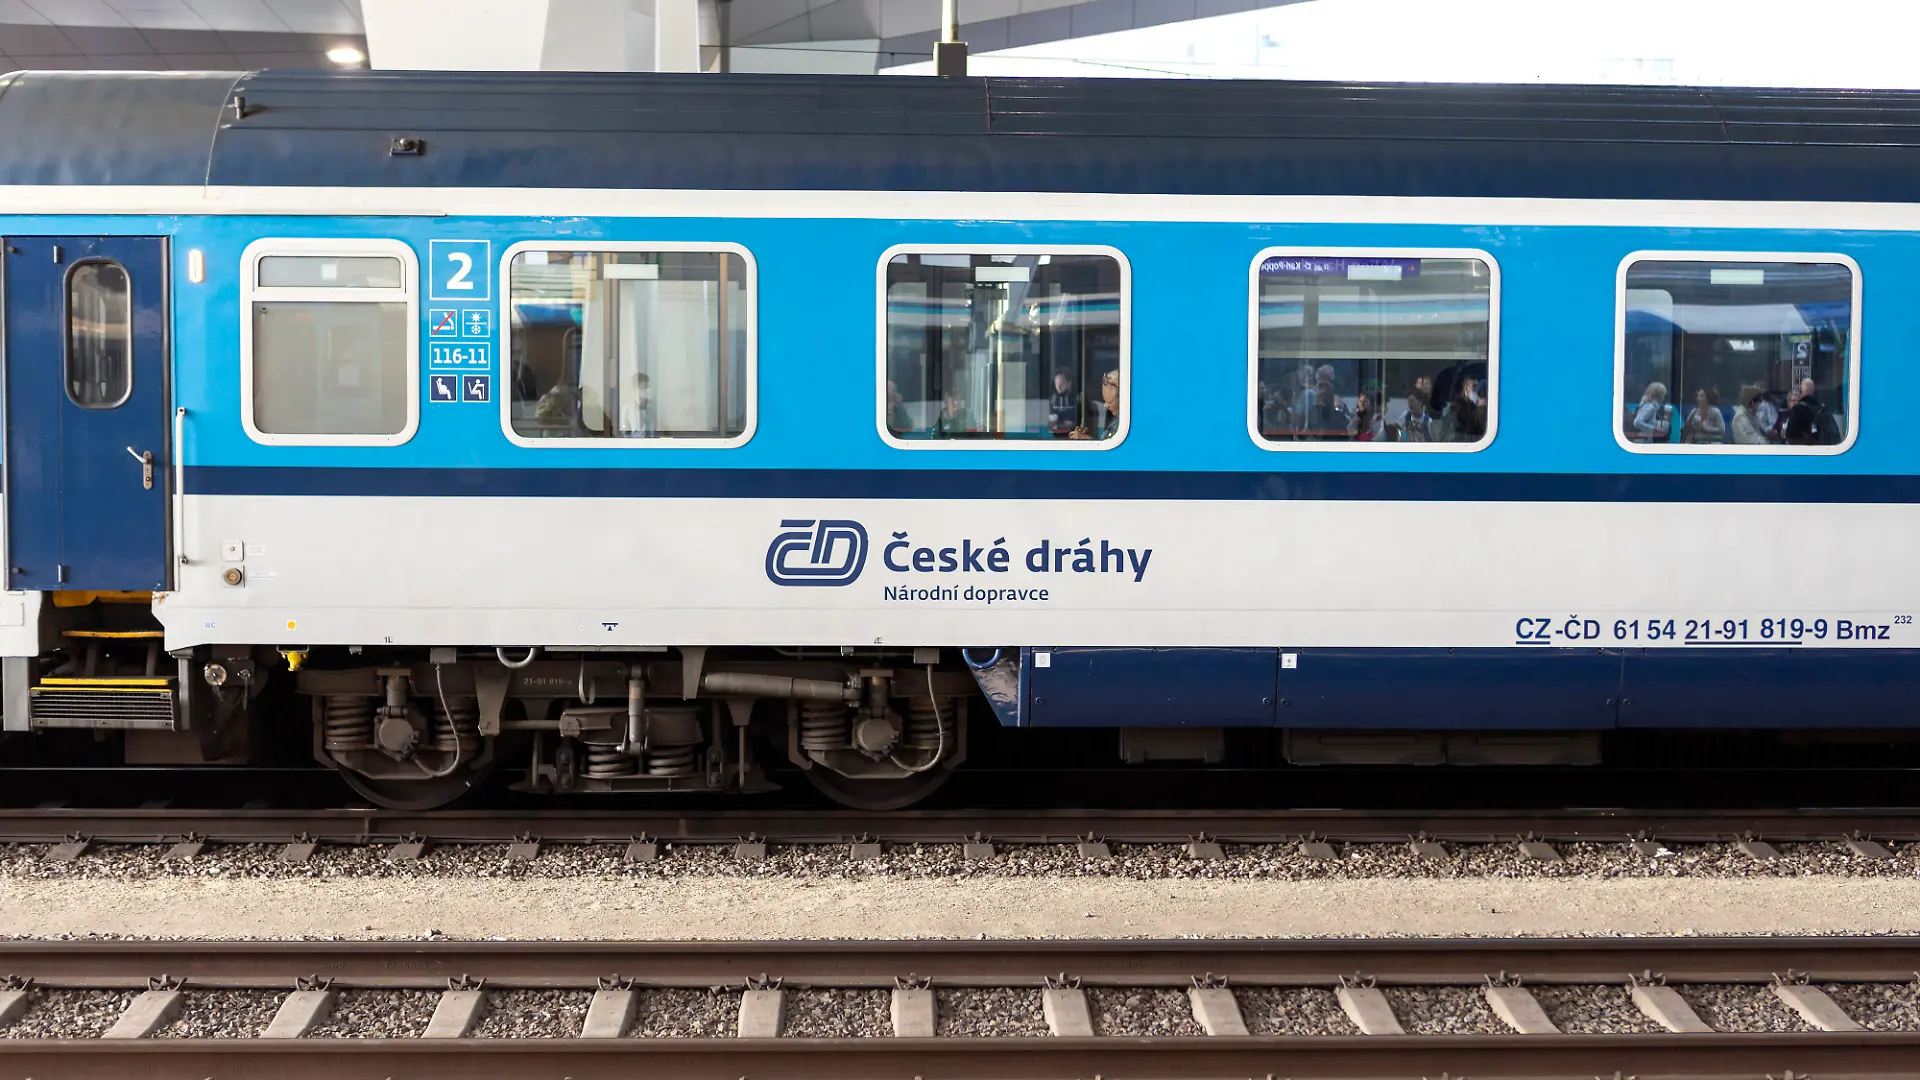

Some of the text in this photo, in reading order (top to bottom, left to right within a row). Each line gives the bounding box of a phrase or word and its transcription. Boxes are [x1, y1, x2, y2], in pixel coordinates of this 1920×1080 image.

[447, 252, 473, 289] 2
[433, 348, 487, 364] 116-11
[883, 531, 1152, 582] České dráhy
[884, 585, 1049, 604] Národní dopravce
[1613, 619, 1639, 640] 61
[1647, 619, 1676, 640] 54
[1685, 619, 1748, 640] 21-91
[1760, 618, 1828, 640] 819-9
[1836, 620, 1890, 640] Bmz
[1894, 615, 1912, 624] 232
